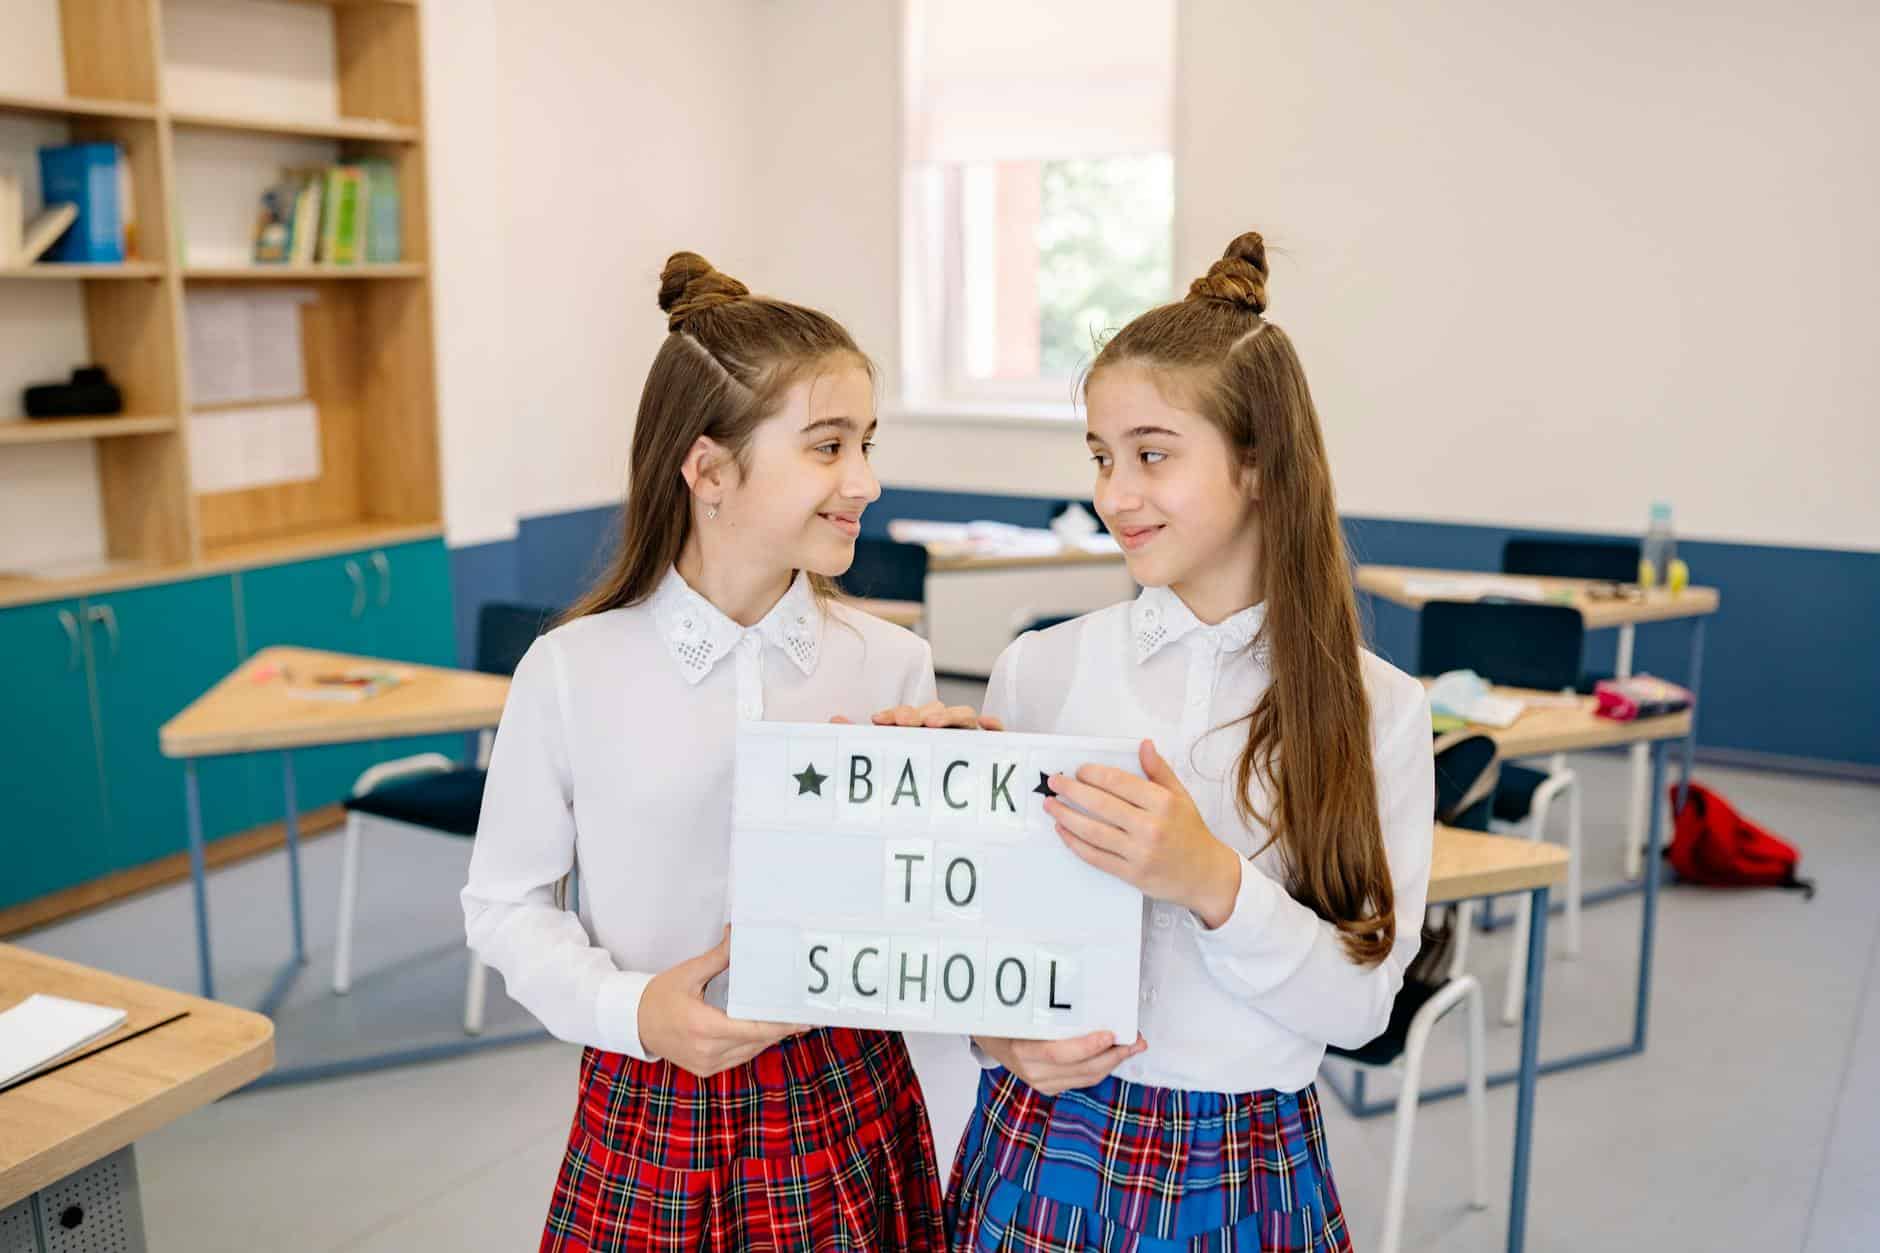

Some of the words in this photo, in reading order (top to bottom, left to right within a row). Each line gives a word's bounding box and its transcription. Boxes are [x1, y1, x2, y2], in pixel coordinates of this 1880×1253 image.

[848, 755, 1017, 812] BACK
[894, 853, 977, 907] TO
[807, 945, 1072, 1010] SCHOOL
